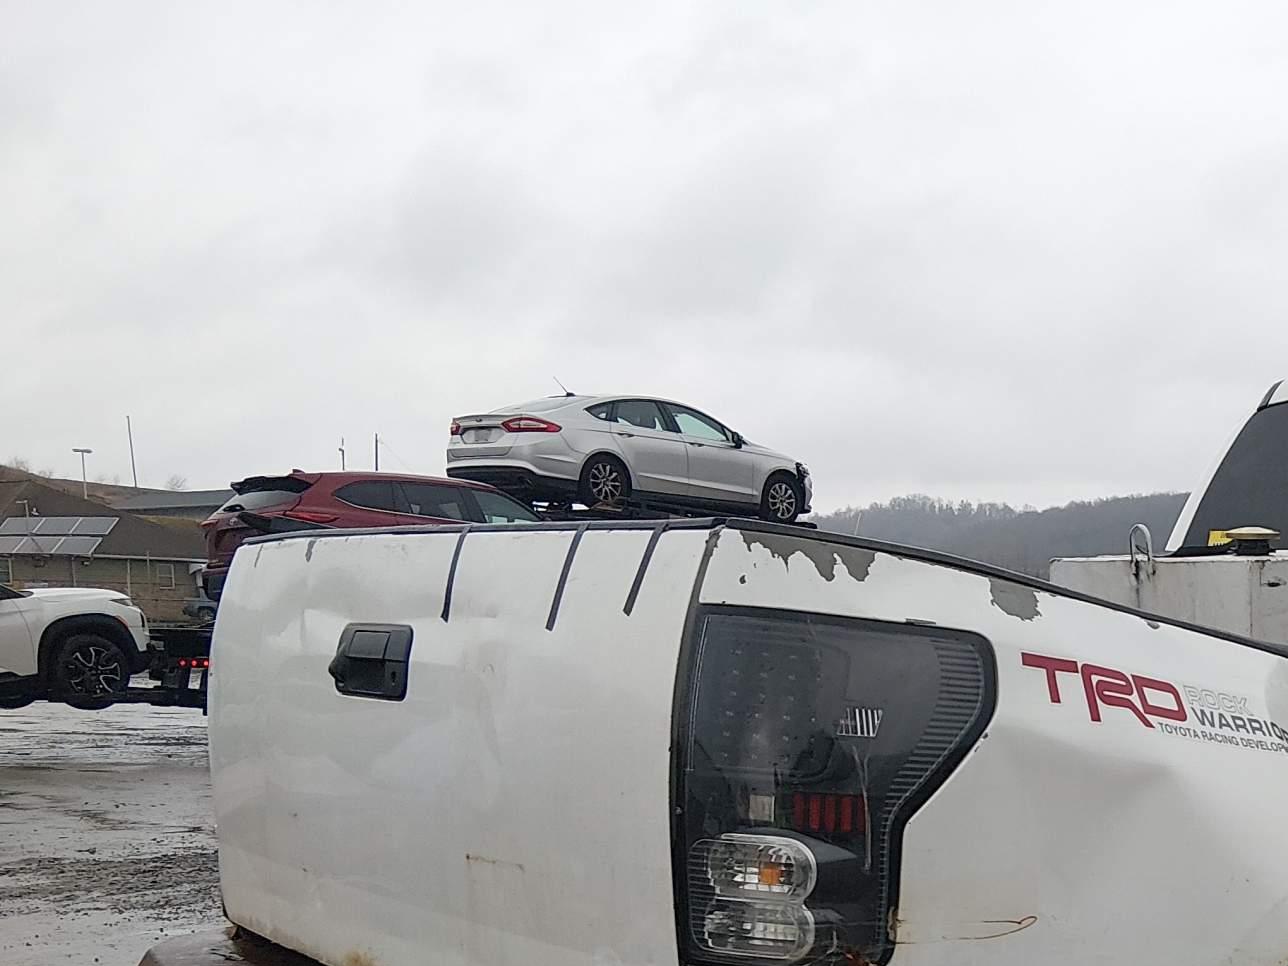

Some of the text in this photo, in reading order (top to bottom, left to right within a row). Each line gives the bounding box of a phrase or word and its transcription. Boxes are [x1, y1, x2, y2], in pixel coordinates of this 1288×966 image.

[1021, 651, 1188, 729] TRD
[1183, 684, 1254, 716] ROCK
[1157, 722, 1201, 740] TOYOTA
[1200, 730, 1239, 746] RACING
